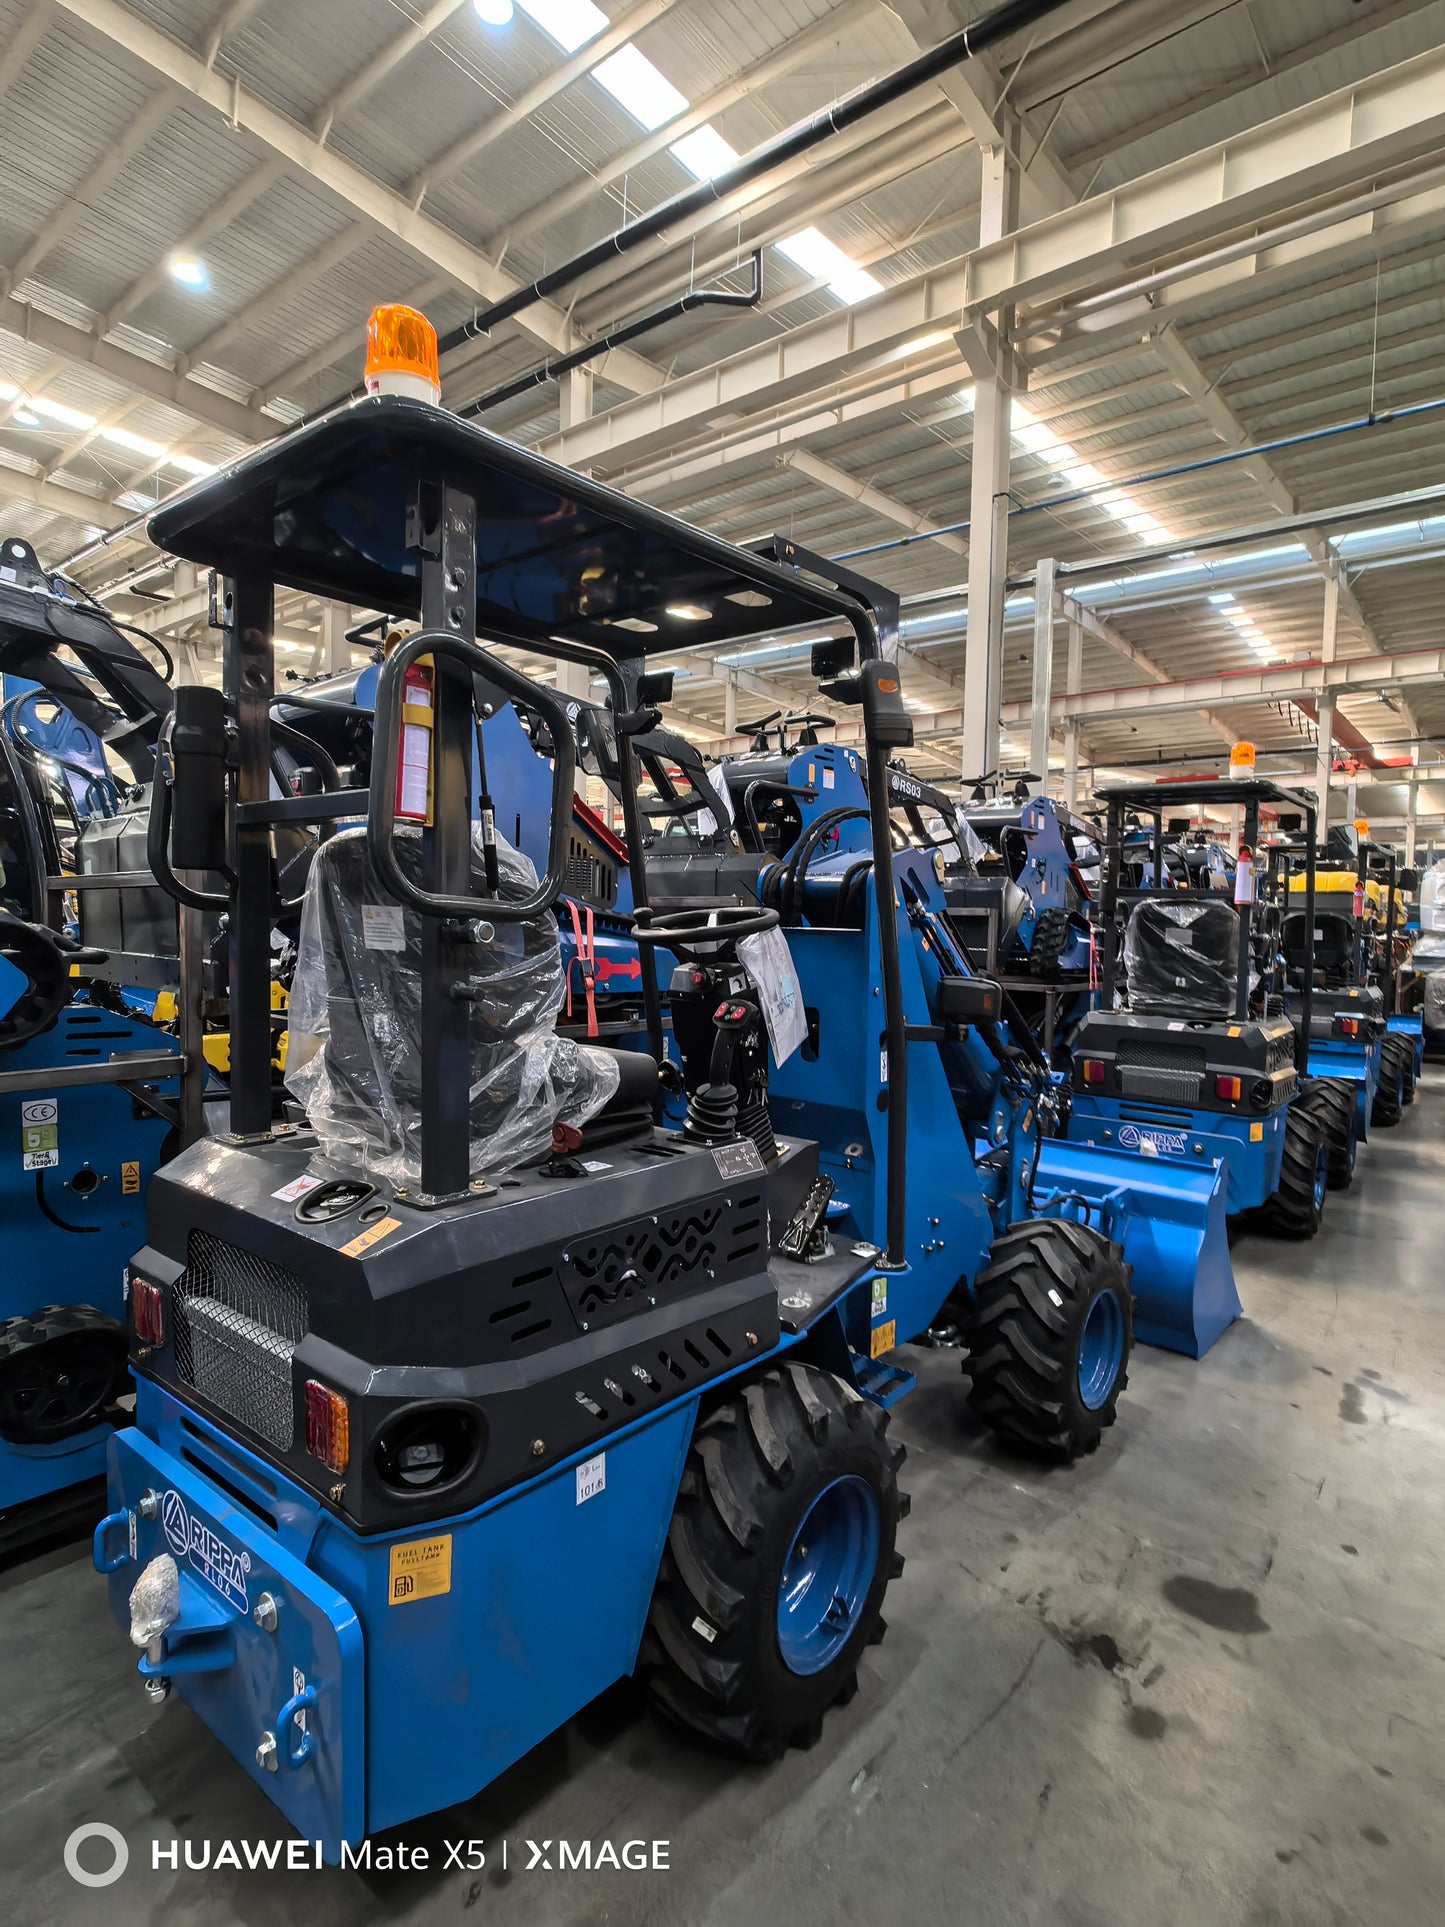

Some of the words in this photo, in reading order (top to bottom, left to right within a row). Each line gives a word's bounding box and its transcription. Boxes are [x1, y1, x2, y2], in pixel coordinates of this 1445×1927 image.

[900, 779, 921, 799] RS03
[31, 1106, 48, 1119] CE
[397, 1549, 418, 1559] FUEL
[204, 1561, 231, 1596] RL06
